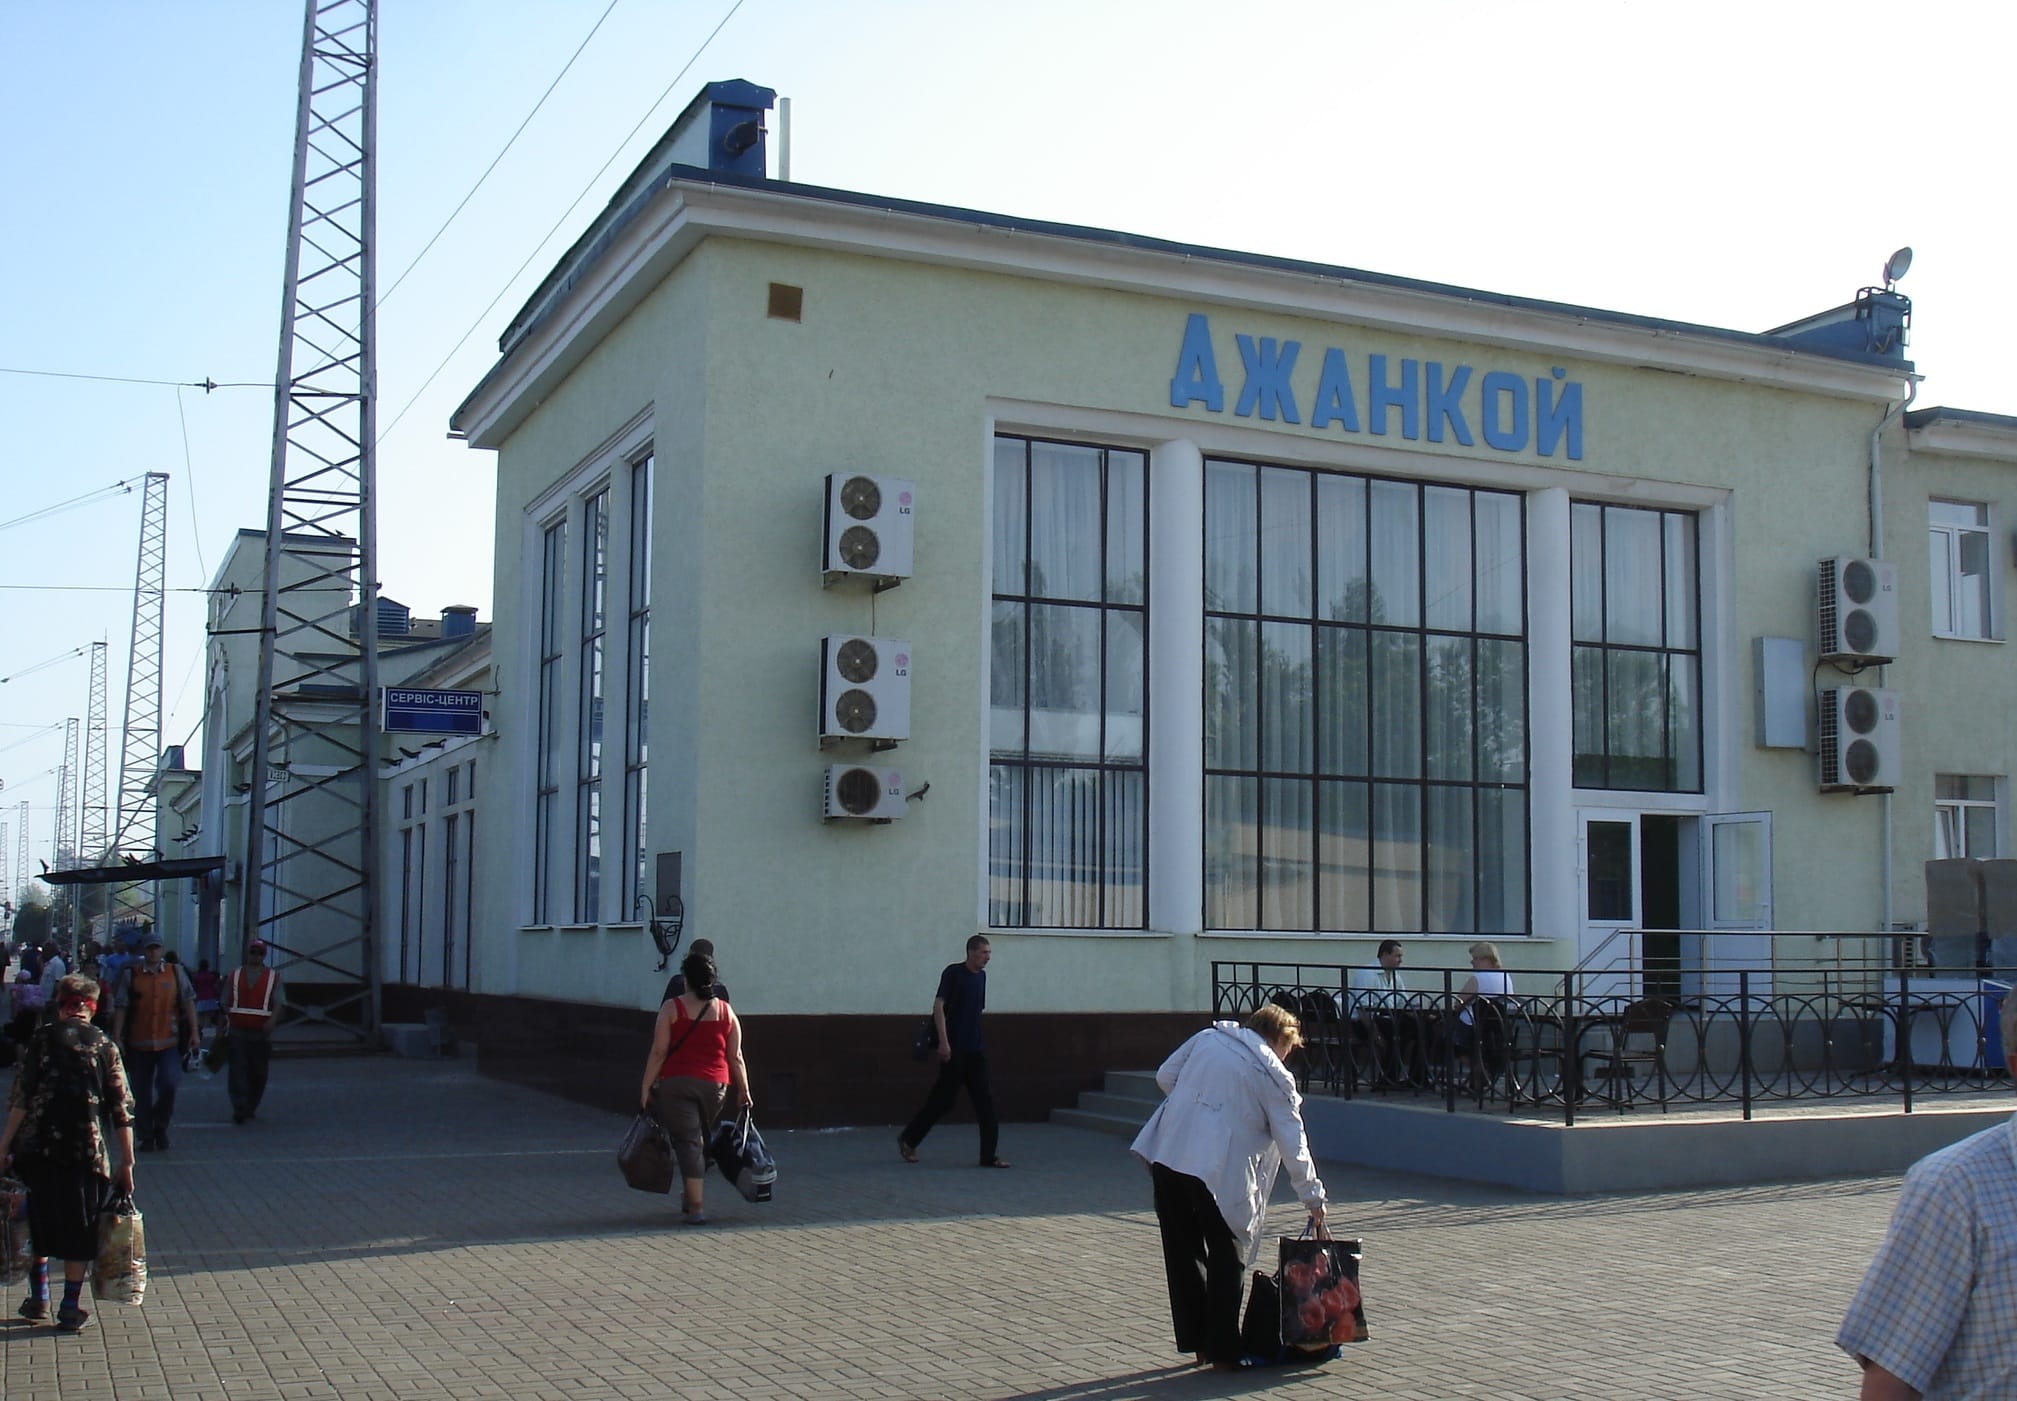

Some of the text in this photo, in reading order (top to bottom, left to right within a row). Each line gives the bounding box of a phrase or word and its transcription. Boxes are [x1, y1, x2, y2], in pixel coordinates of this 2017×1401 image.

[1170, 313, 1583, 460] ДЖАНКОЙ
[899, 507, 911, 515] LG
[895, 669, 907, 677] LG
[390, 693, 478, 706] СЕРВІС-ЦЕНТР
[888, 788, 900, 796] LG
